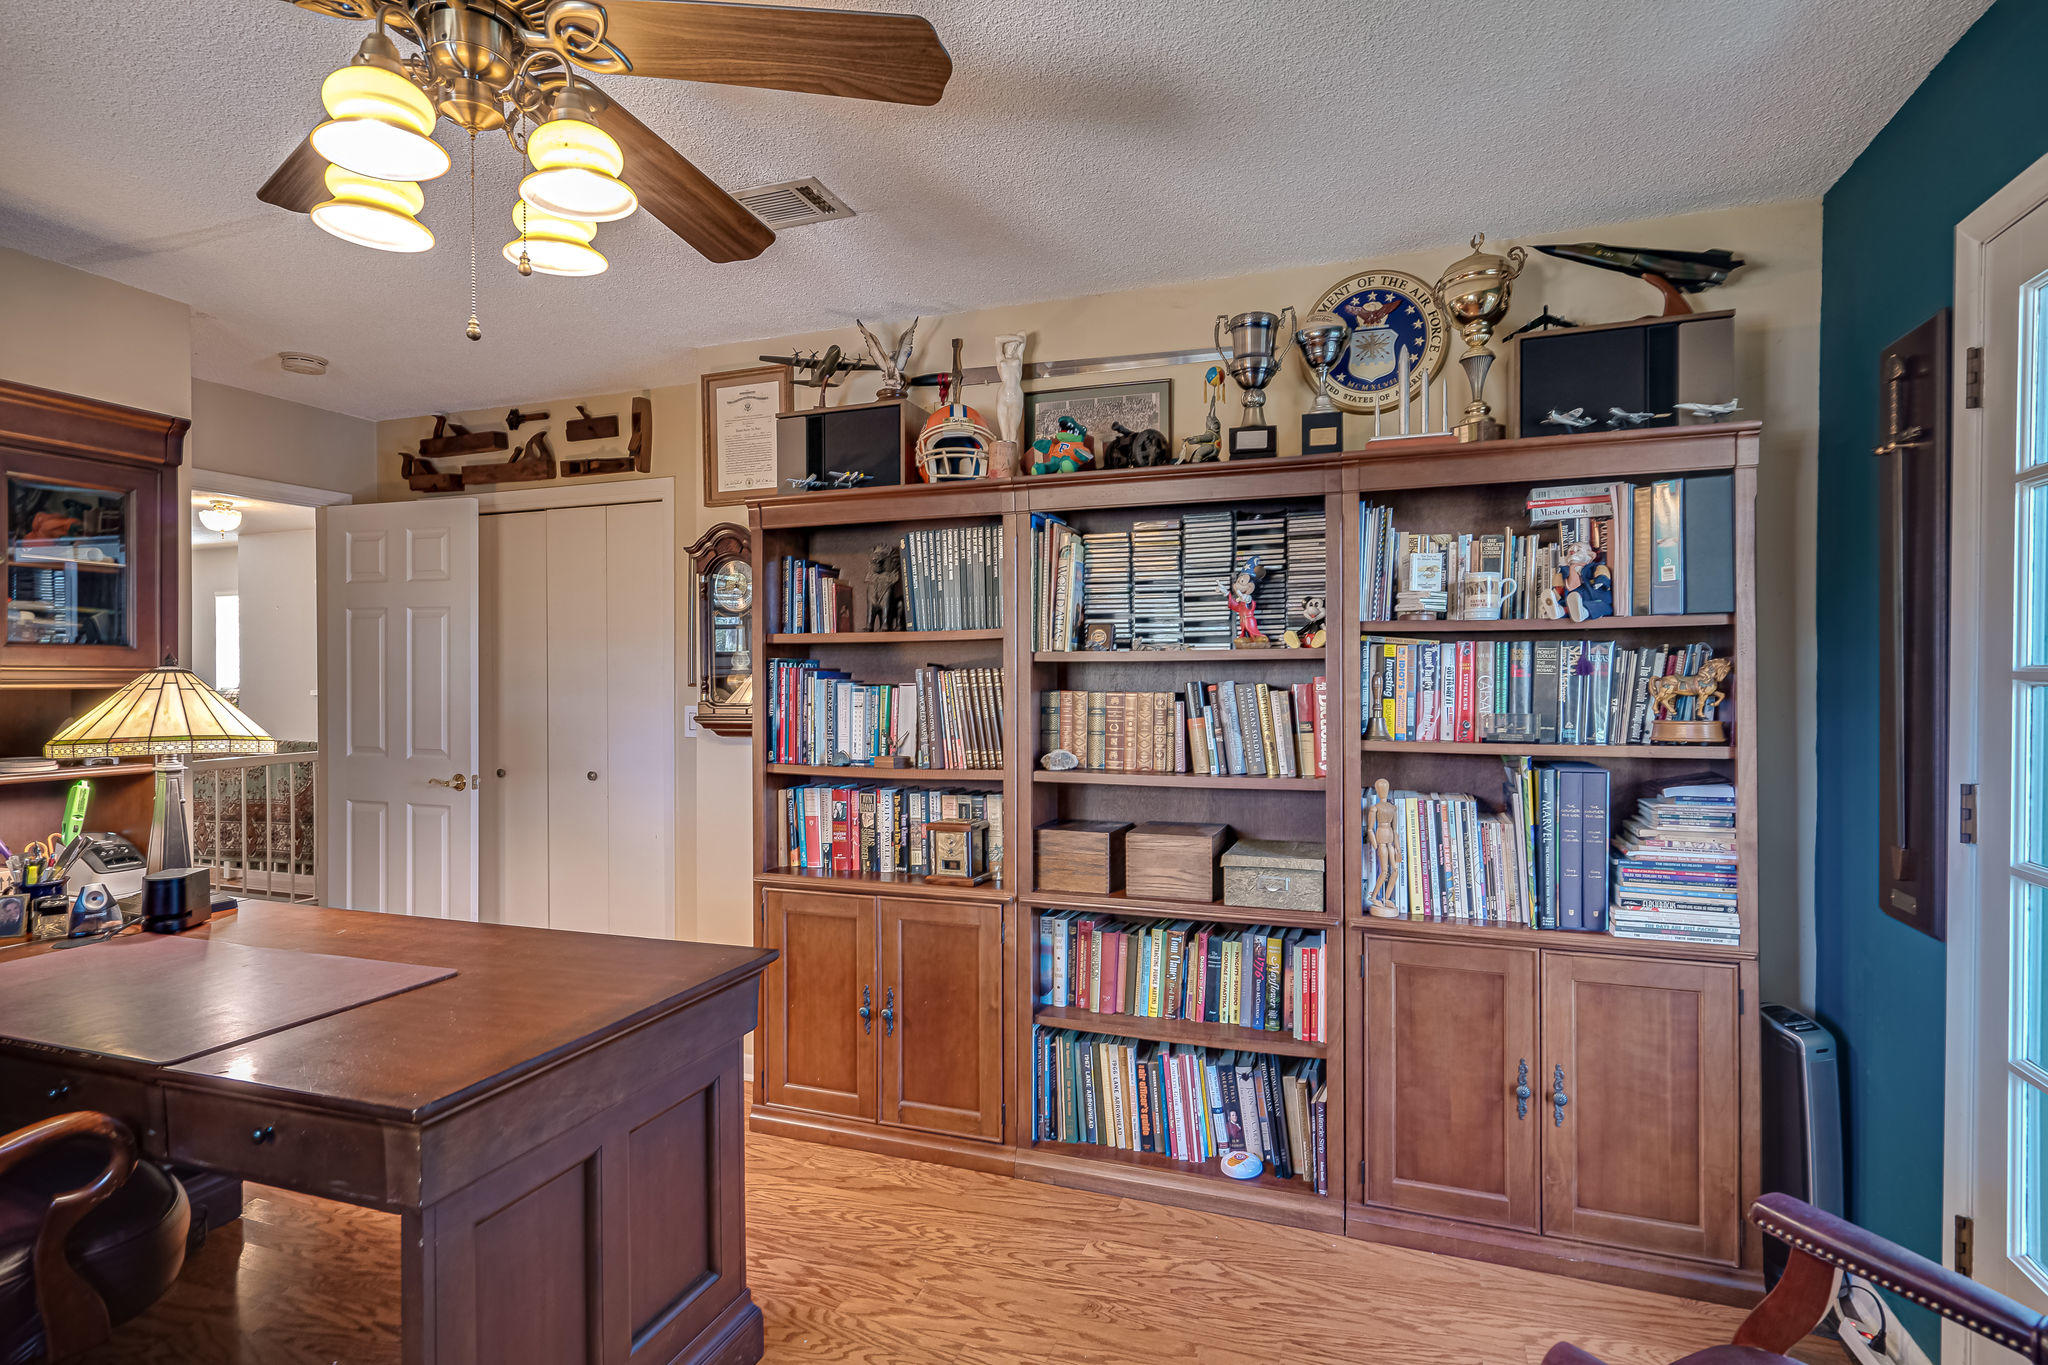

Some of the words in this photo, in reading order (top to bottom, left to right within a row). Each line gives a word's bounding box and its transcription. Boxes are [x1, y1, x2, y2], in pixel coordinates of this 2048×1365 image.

[1317, 284, 1352, 313] MENT
[1357, 275, 1376, 288] OF
[1380, 275, 1409, 290] THE
[1409, 287, 1431, 308] AIR
[1427, 309, 1442, 353] FORCE
[1343, 392, 1374, 404] STATES
[1379, 393, 1391, 402] OF
[1540, 508, 1567, 517] Master
[1567, 506, 1589, 514] Cook
[1056, 565, 1067, 607] WORLD
[1054, 609, 1066, 642] ATLAS
[1385, 658, 1394, 697] Investing
[1640, 666, 1651, 676] The
[1239, 689, 1247, 716] GENERAL
[1636, 678, 1650, 703] Complete
[1246, 687, 1257, 726] AMERICAN
[1251, 730, 1261, 762] SOLDIER
[862, 804, 874, 813] RAND
[1542, 800, 1552, 843] MARVEL
[1171, 936, 1182, 953] Tom
[1167, 955, 1181, 982] Clancy
[1253, 957, 1264, 979] 1776
[1268, 955, 1278, 1008] Mayflower
[1139, 1069, 1147, 1080] air
[1221, 1072, 1230, 1103] AMERICAN
[1261, 1062, 1273, 1112] THOMASONIAN
[1139, 1081, 1149, 1113] officer's
[1246, 1087, 1254, 1105] JOHN
[1270, 1067, 1281, 1117] THOMASONIAN
[1086, 1089, 1094, 1129] ARROWHEAD
[1141, 1114, 1150, 1136] guide
[1317, 1139, 1325, 1154] Strip
